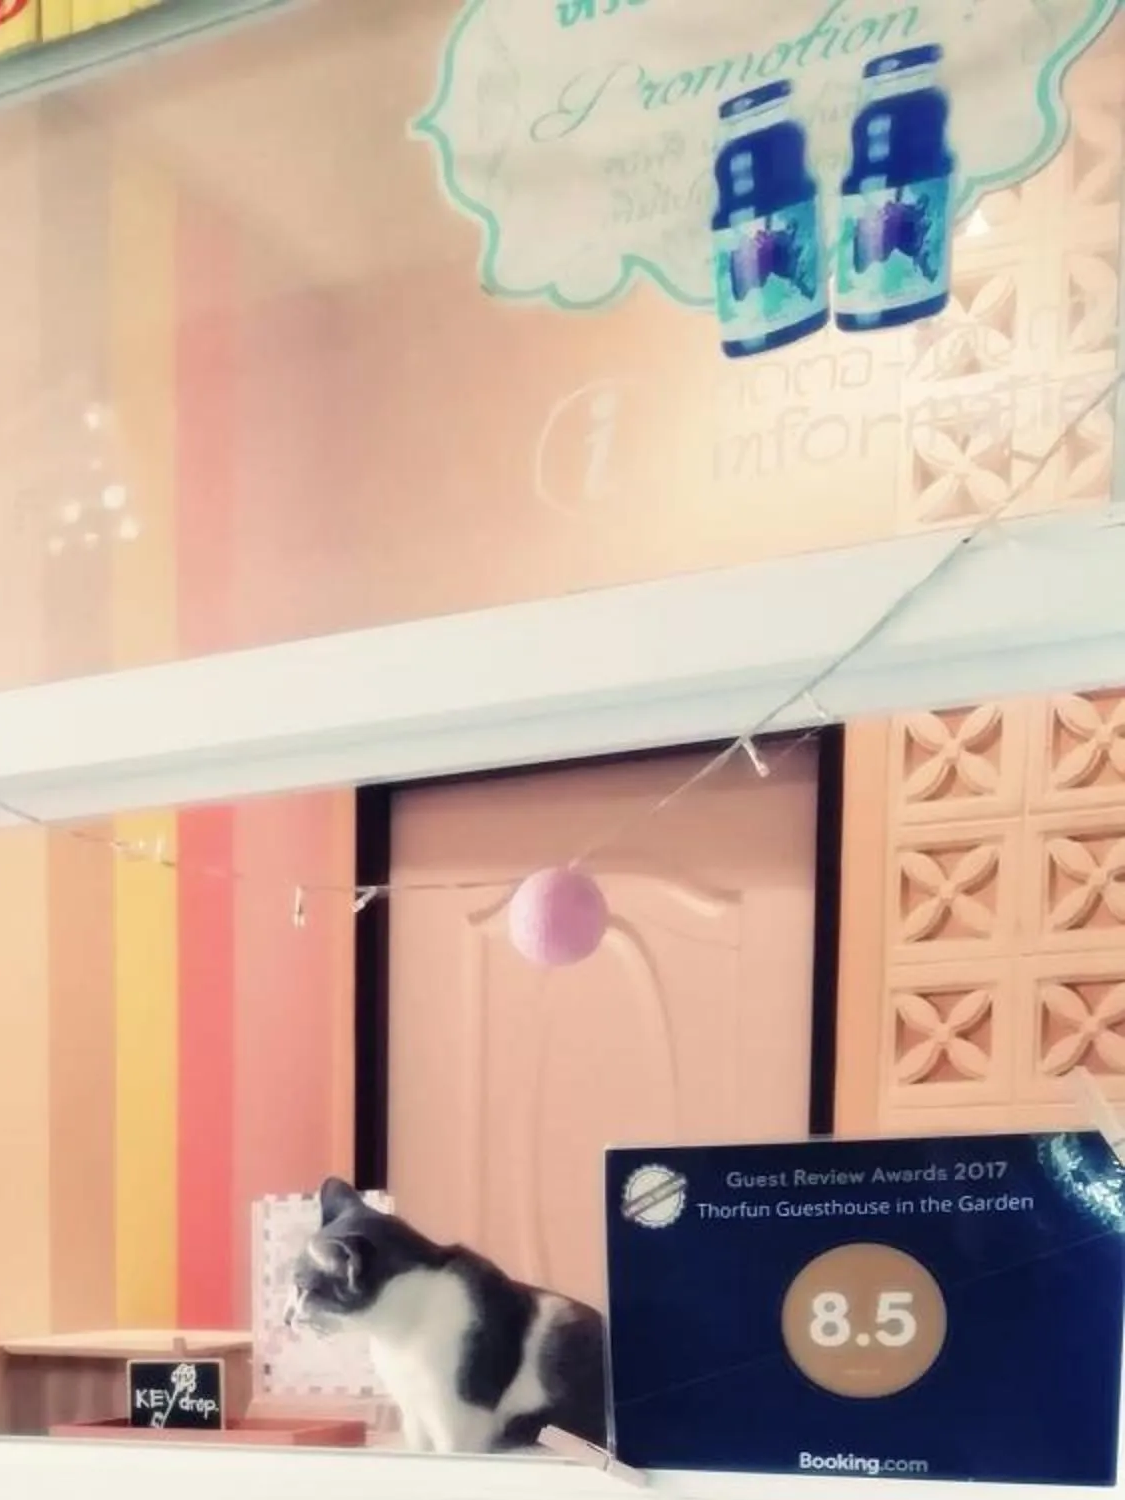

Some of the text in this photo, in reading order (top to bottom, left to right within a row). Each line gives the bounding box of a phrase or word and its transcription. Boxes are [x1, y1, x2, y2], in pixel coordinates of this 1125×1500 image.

[529, 0, 921, 143] Promotion
[726, 1161, 1008, 1188] Guest Review Awards 2017
[698, 1193, 1034, 1220] Thorfun Guesthouse in the Garden
[809, 1291, 919, 1348] 8.5
[135, 1388, 174, 1409] KEY
[799, 1451, 929, 1475] Booking.com
